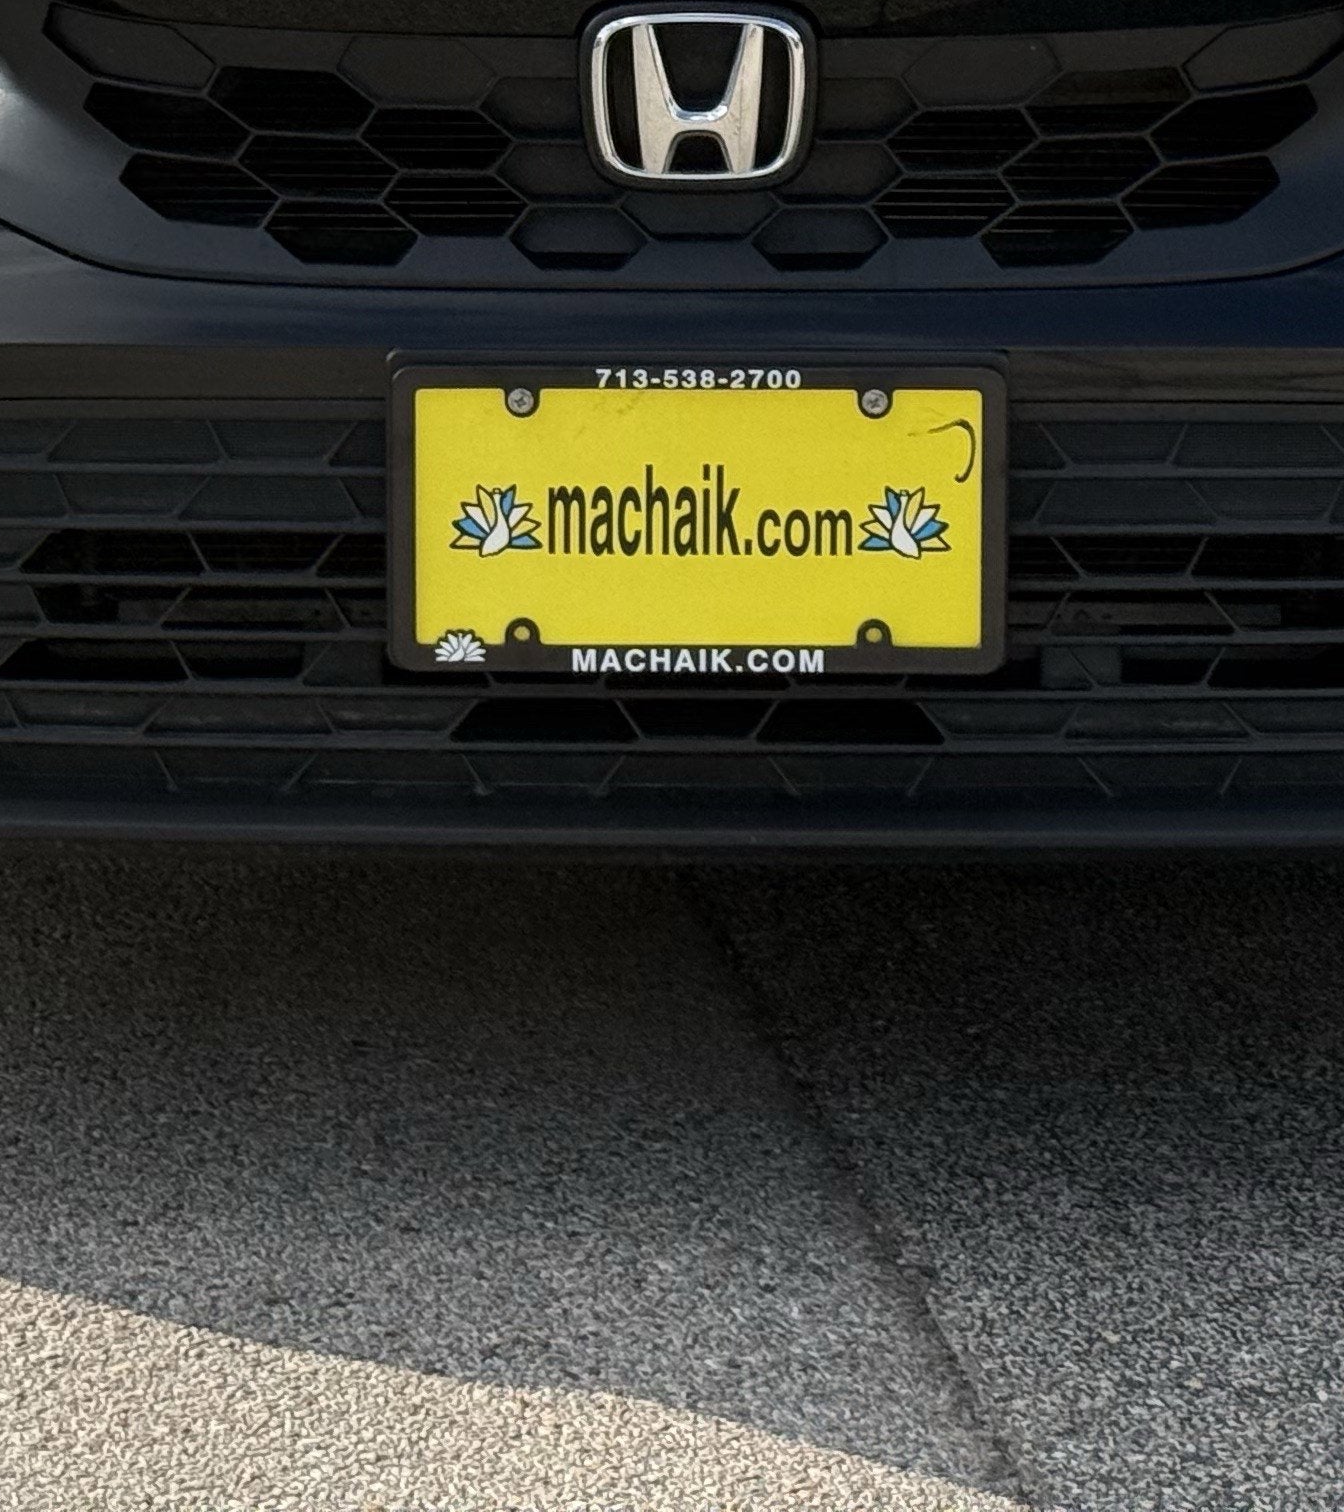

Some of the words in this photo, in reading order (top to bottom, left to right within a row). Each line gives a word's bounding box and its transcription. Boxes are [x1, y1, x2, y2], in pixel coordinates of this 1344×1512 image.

[595, 368, 803, 390] 713-538-2700
[546, 463, 855, 556] machaik.com
[571, 647, 826, 674] MACHAIK.COM
